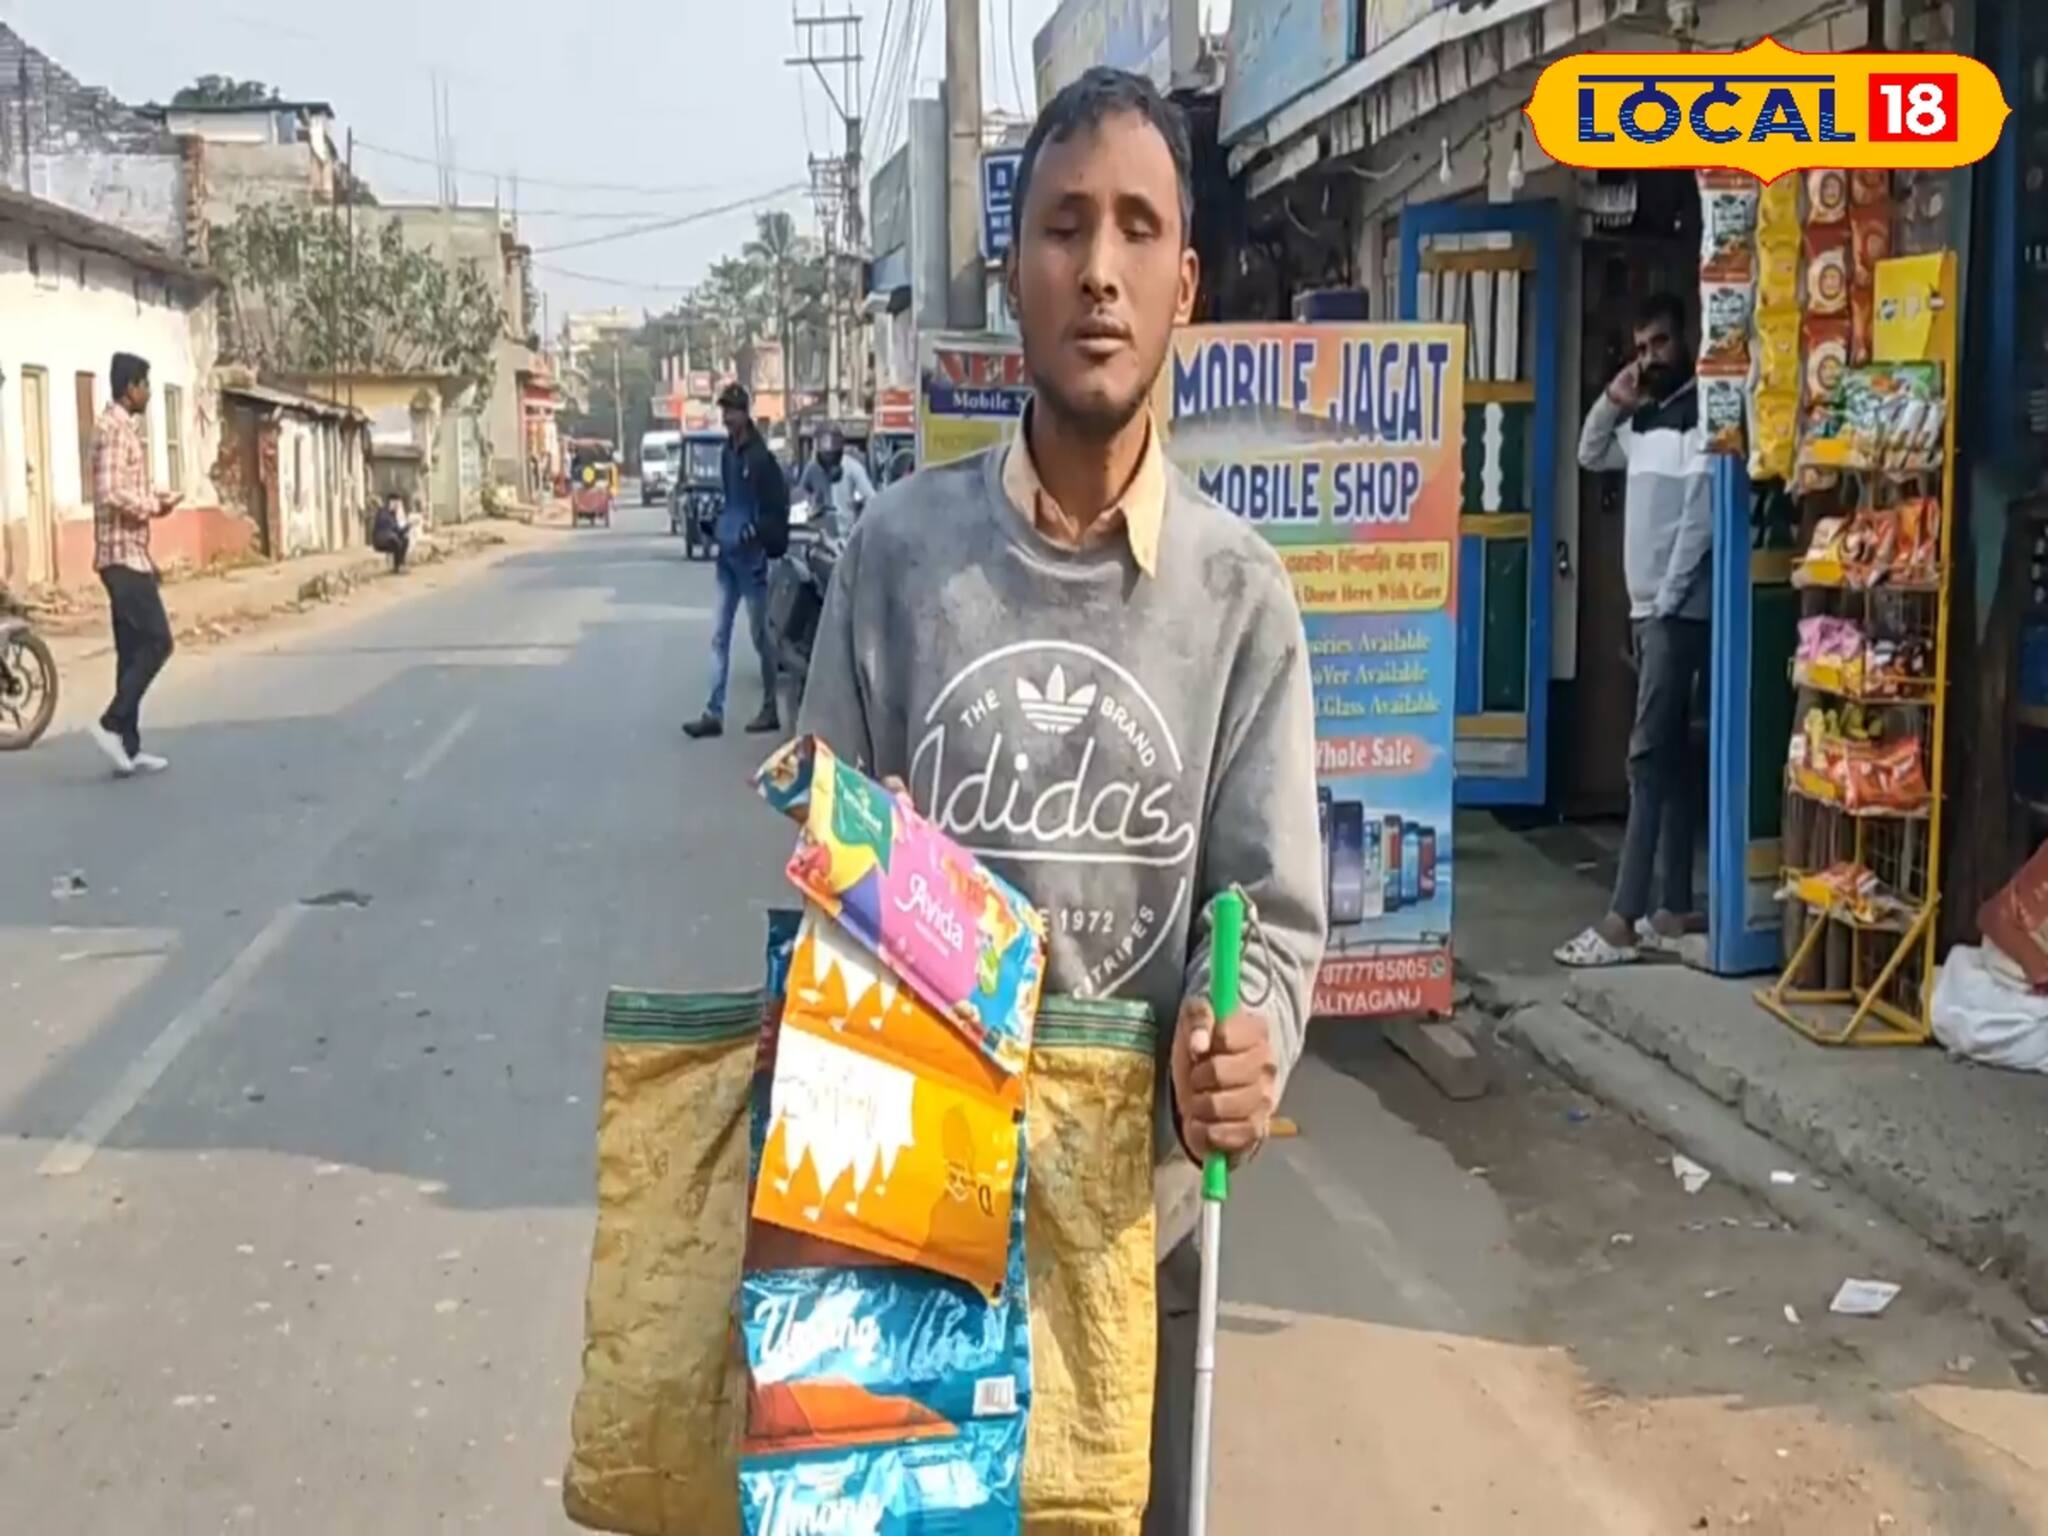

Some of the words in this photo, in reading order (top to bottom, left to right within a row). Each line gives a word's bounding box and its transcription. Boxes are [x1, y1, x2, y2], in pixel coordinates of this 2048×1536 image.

[952, 391, 1010, 410] Mobile
[1329, 341, 1449, 441] JAGAT
[1199, 462, 1320, 519] MOBILE
[1334, 462, 1420, 517] SHOP
[1359, 630, 1431, 652] Available
[1357, 662, 1429, 684] Available
[1371, 692, 1441, 715] Available
[959, 689, 1000, 729] THE
[1100, 696, 1157, 768] BRAND
[1371, 738, 1412, 766] Sale
[908, 721, 1196, 850] Adidas
[1060, 910, 1115, 935] 1972
